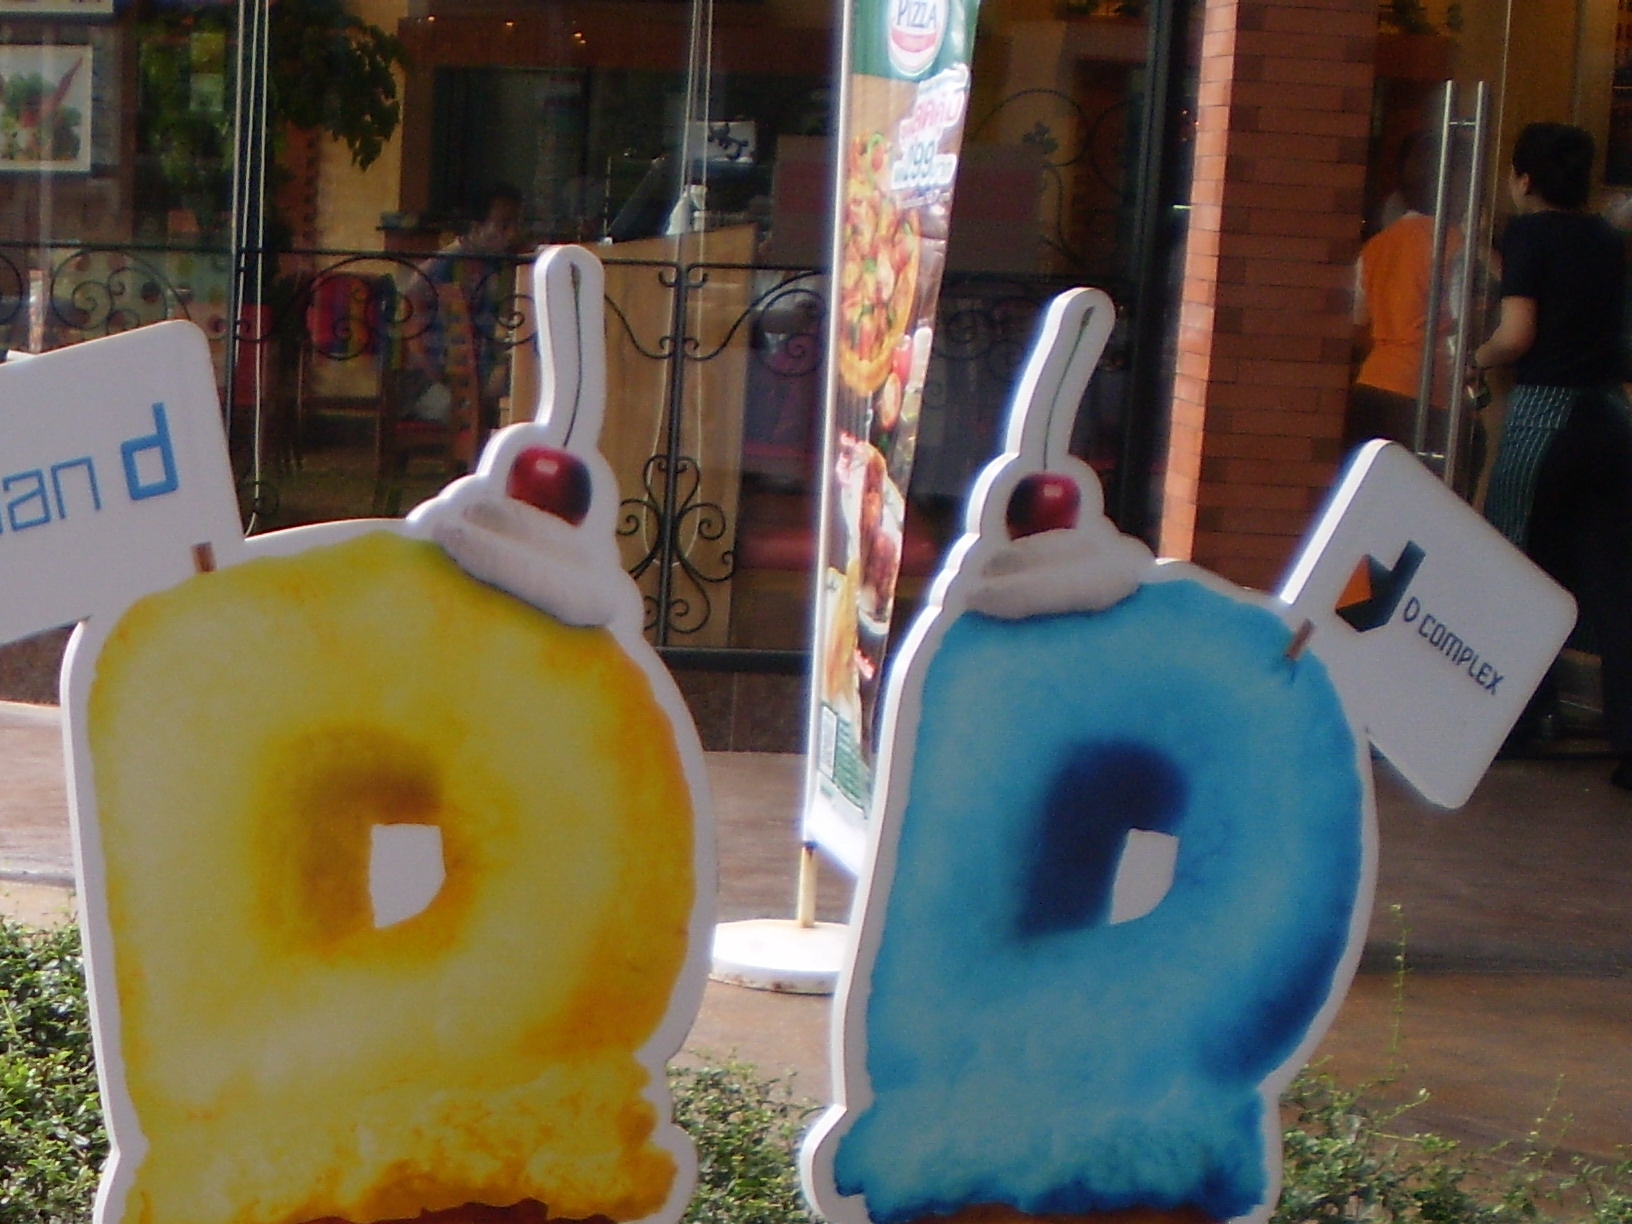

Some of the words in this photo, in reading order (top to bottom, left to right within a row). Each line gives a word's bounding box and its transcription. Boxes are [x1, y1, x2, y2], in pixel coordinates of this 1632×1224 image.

[120, 401, 179, 501] d
[1403, 597, 1421, 622] D
[1418, 613, 1504, 696] COMPLEX
